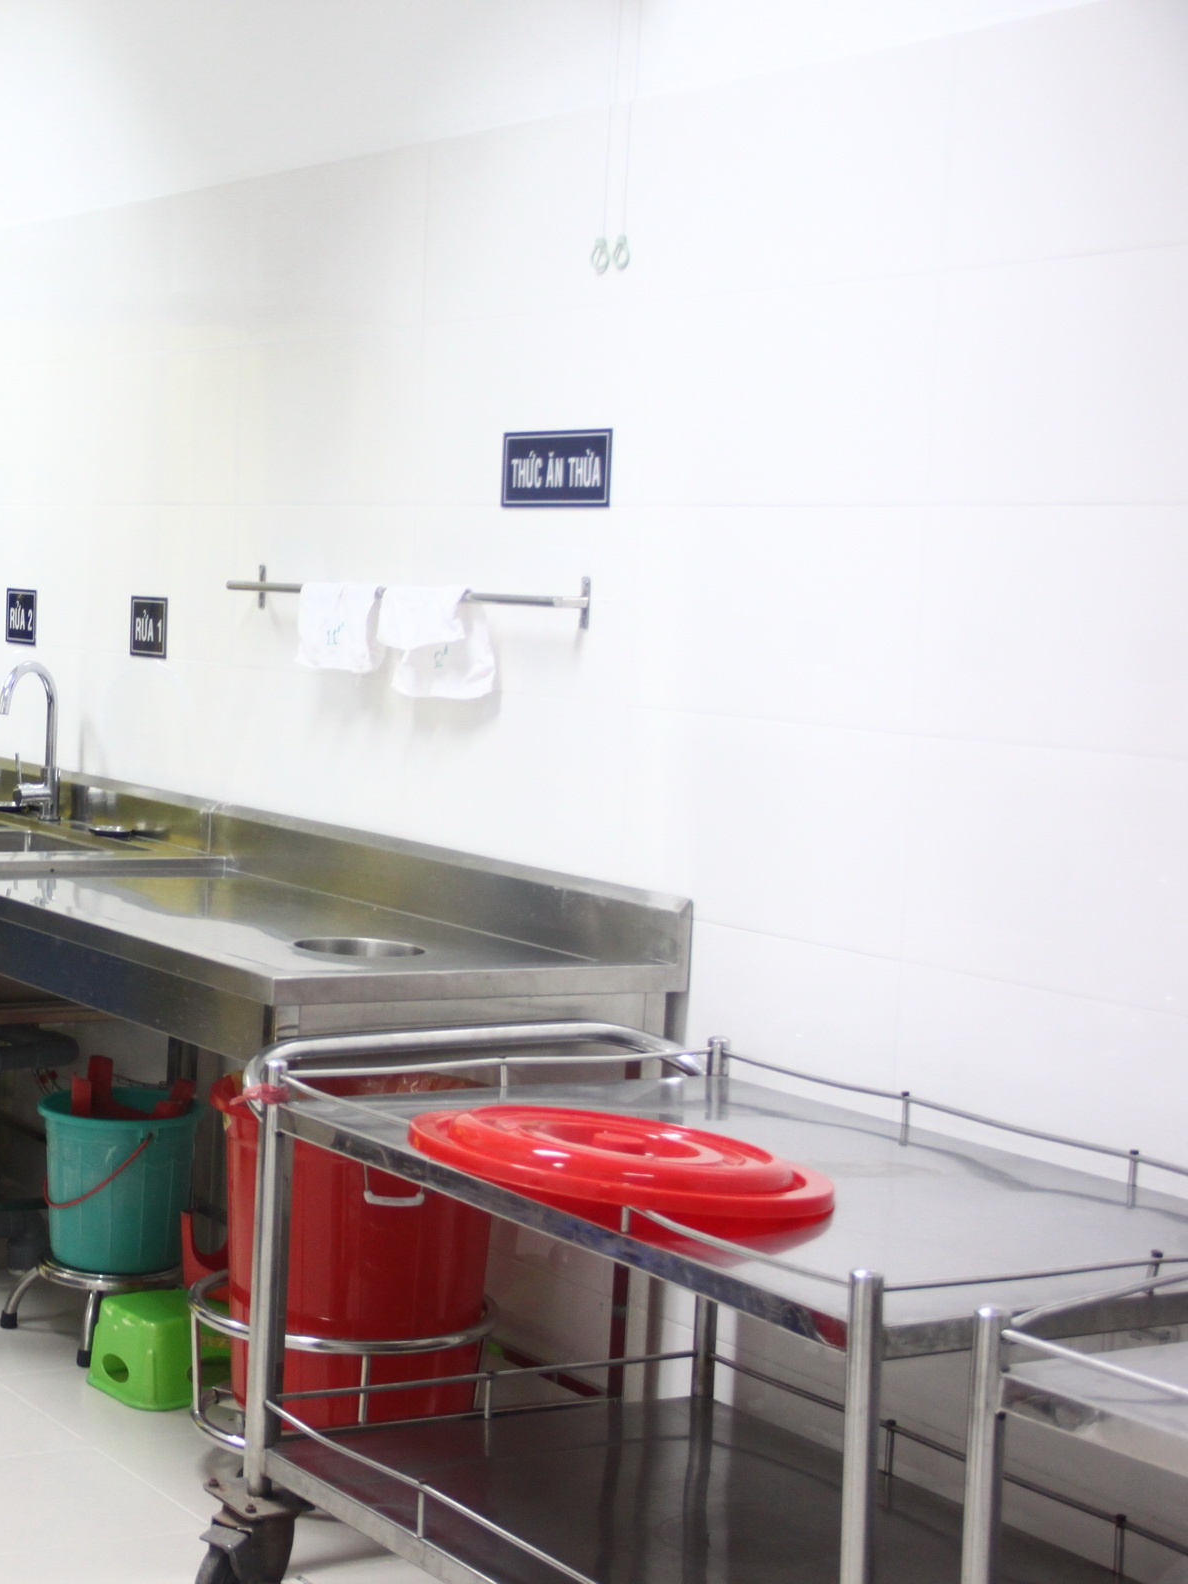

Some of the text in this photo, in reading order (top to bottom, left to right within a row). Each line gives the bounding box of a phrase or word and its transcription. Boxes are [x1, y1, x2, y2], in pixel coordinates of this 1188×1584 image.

[511, 447, 602, 489] THỨC ĂN THỪA
[9, 600, 33, 632] RỬA 2
[135, 609, 163, 643] RỬA 1
